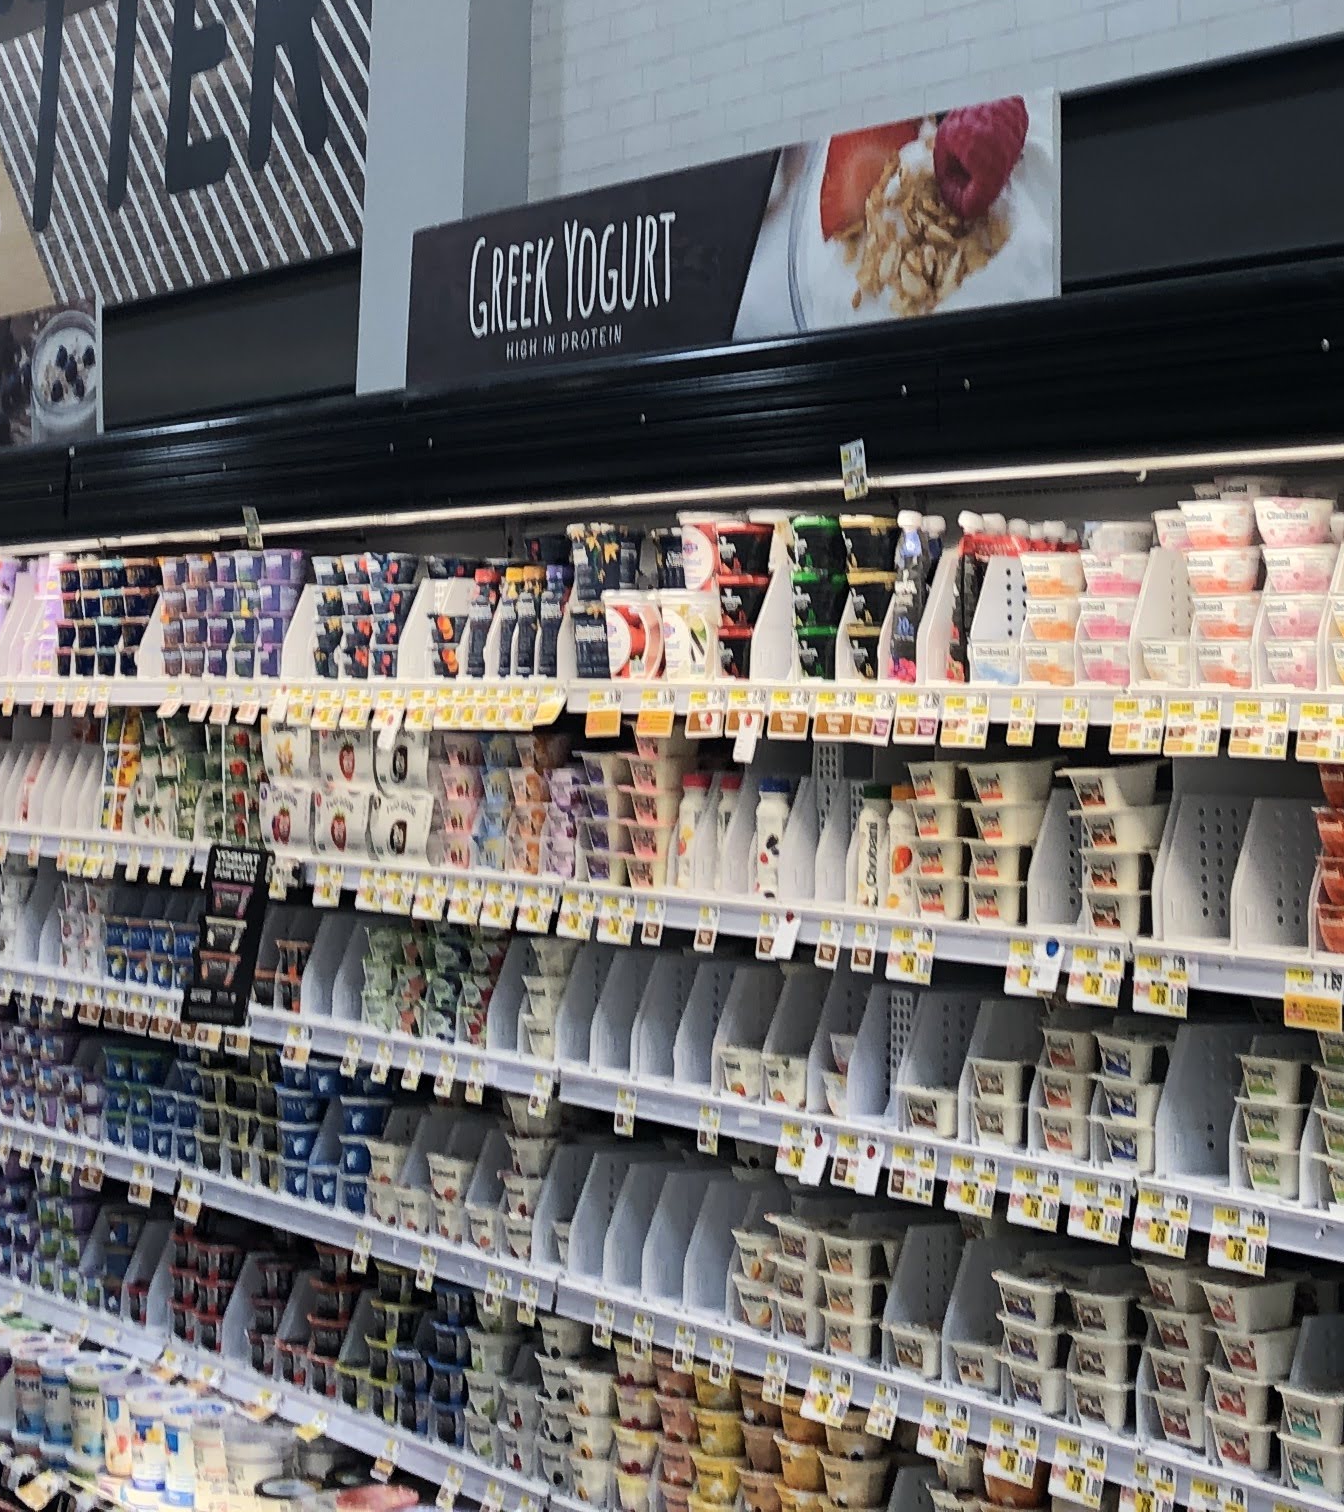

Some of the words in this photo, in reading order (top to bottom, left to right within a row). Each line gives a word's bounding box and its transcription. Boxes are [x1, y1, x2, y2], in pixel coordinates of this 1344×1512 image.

[468, 237, 556, 339] GREEK
[563, 212, 676, 318] YOGURT
[506, 337, 538, 361] HIGH
[542, 333, 556, 355] IN
[560, 323, 623, 353] PROTEIN
[1324, 972, 1342, 991] 1.69
